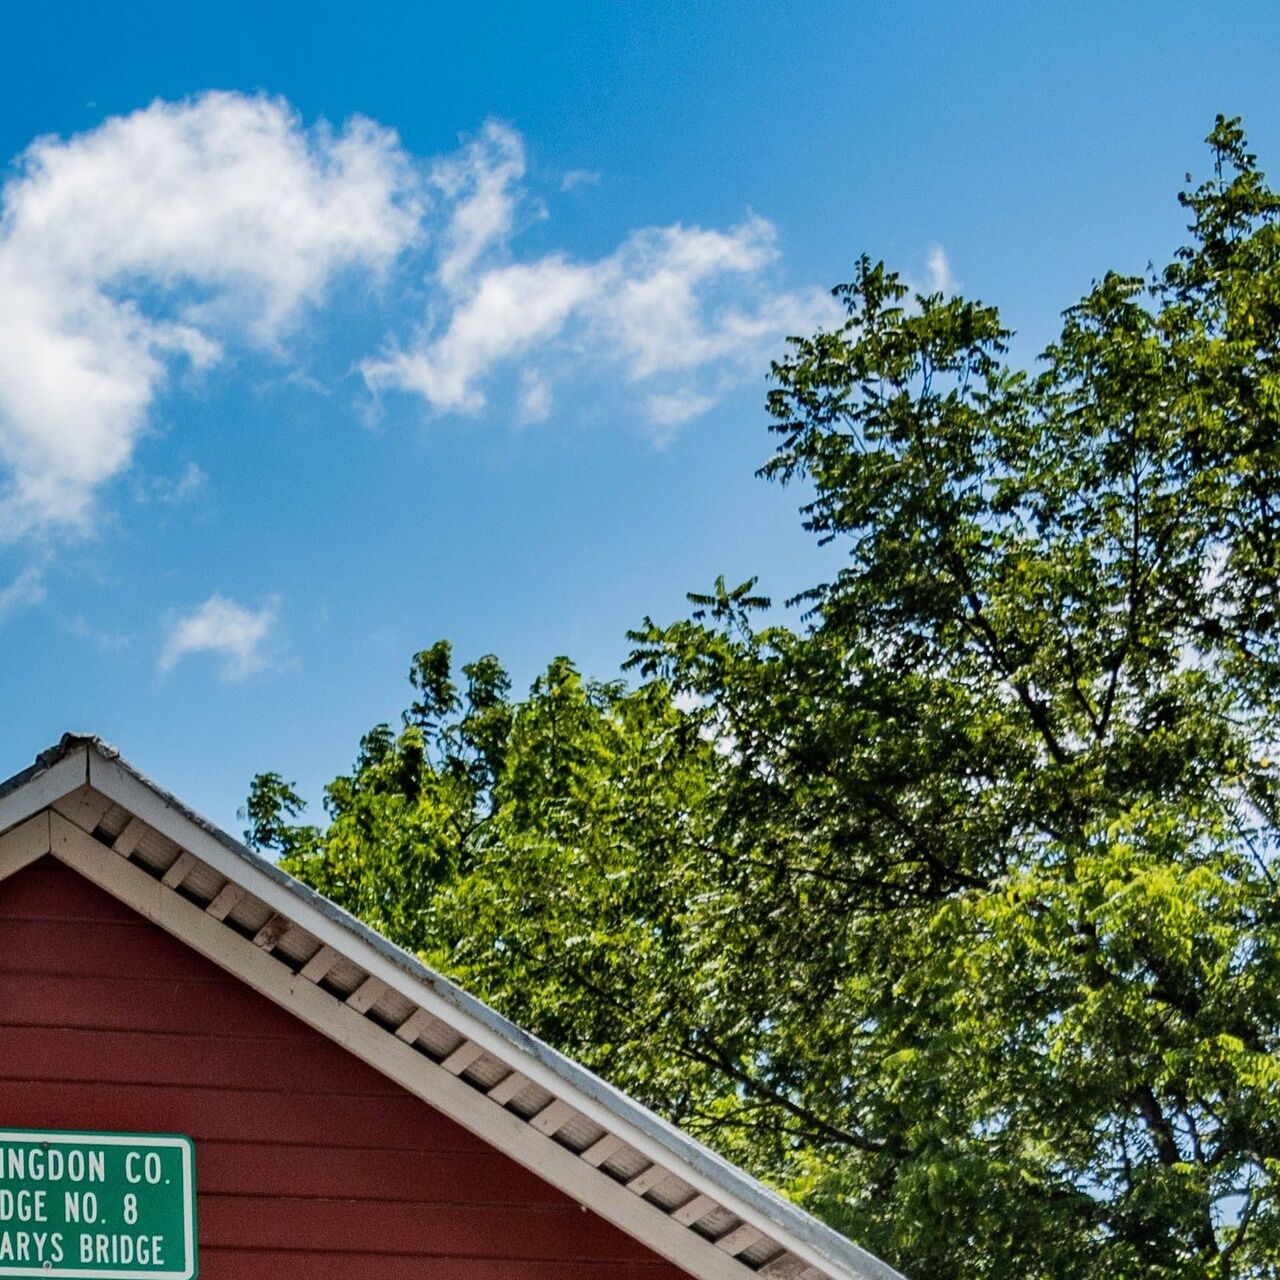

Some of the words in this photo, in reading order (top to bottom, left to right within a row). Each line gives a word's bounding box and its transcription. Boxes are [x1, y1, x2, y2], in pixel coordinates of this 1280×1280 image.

[125, 1152, 171, 1185] CO.
[64, 1192, 106, 1225] NO.
[123, 1194, 138, 1226] 8
[79, 1234, 165, 1266] BRIDGE
